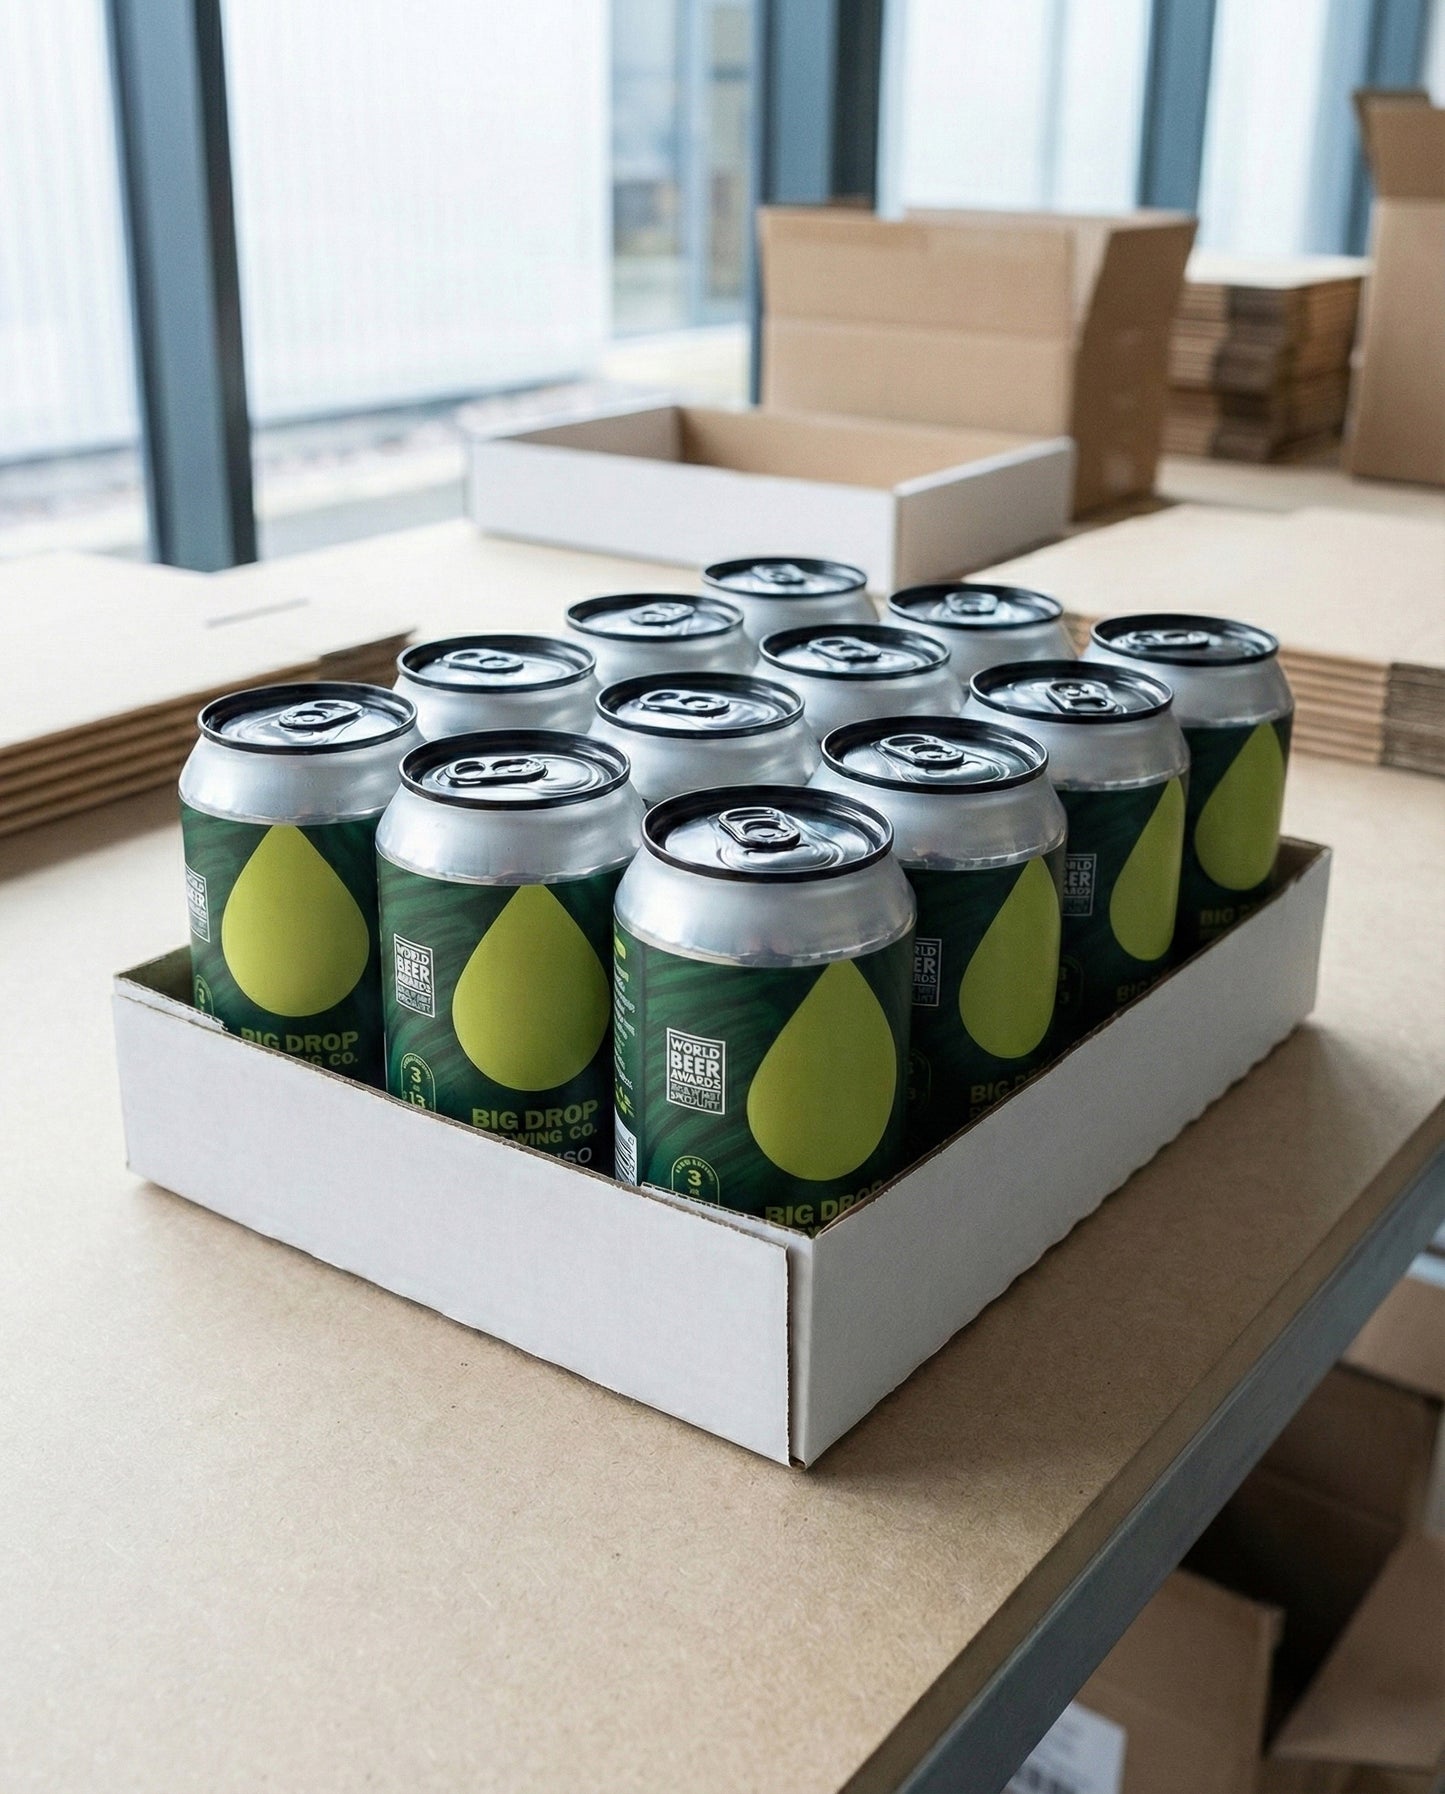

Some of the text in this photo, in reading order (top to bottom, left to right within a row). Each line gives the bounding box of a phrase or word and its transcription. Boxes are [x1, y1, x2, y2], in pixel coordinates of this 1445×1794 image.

[1065, 871, 1091, 887] ER
[914, 946, 937, 957] RLD
[397, 954, 431, 984] BEER
[913, 957, 936, 974] ER
[285, 1031, 359, 1053] DROP
[670, 1037, 720, 1060] WORLD
[329, 1052, 359, 1066] CO.
[670, 1049, 721, 1080] BEER
[411, 1066, 422, 1083] 3
[670, 1068, 722, 1090] AWARDS
[472, 1100, 598, 1130] BIG DROP
[502, 1122, 597, 1146] WING CO.
[687, 1169, 702, 1187] 3
[765, 1204, 815, 1227] BIG
